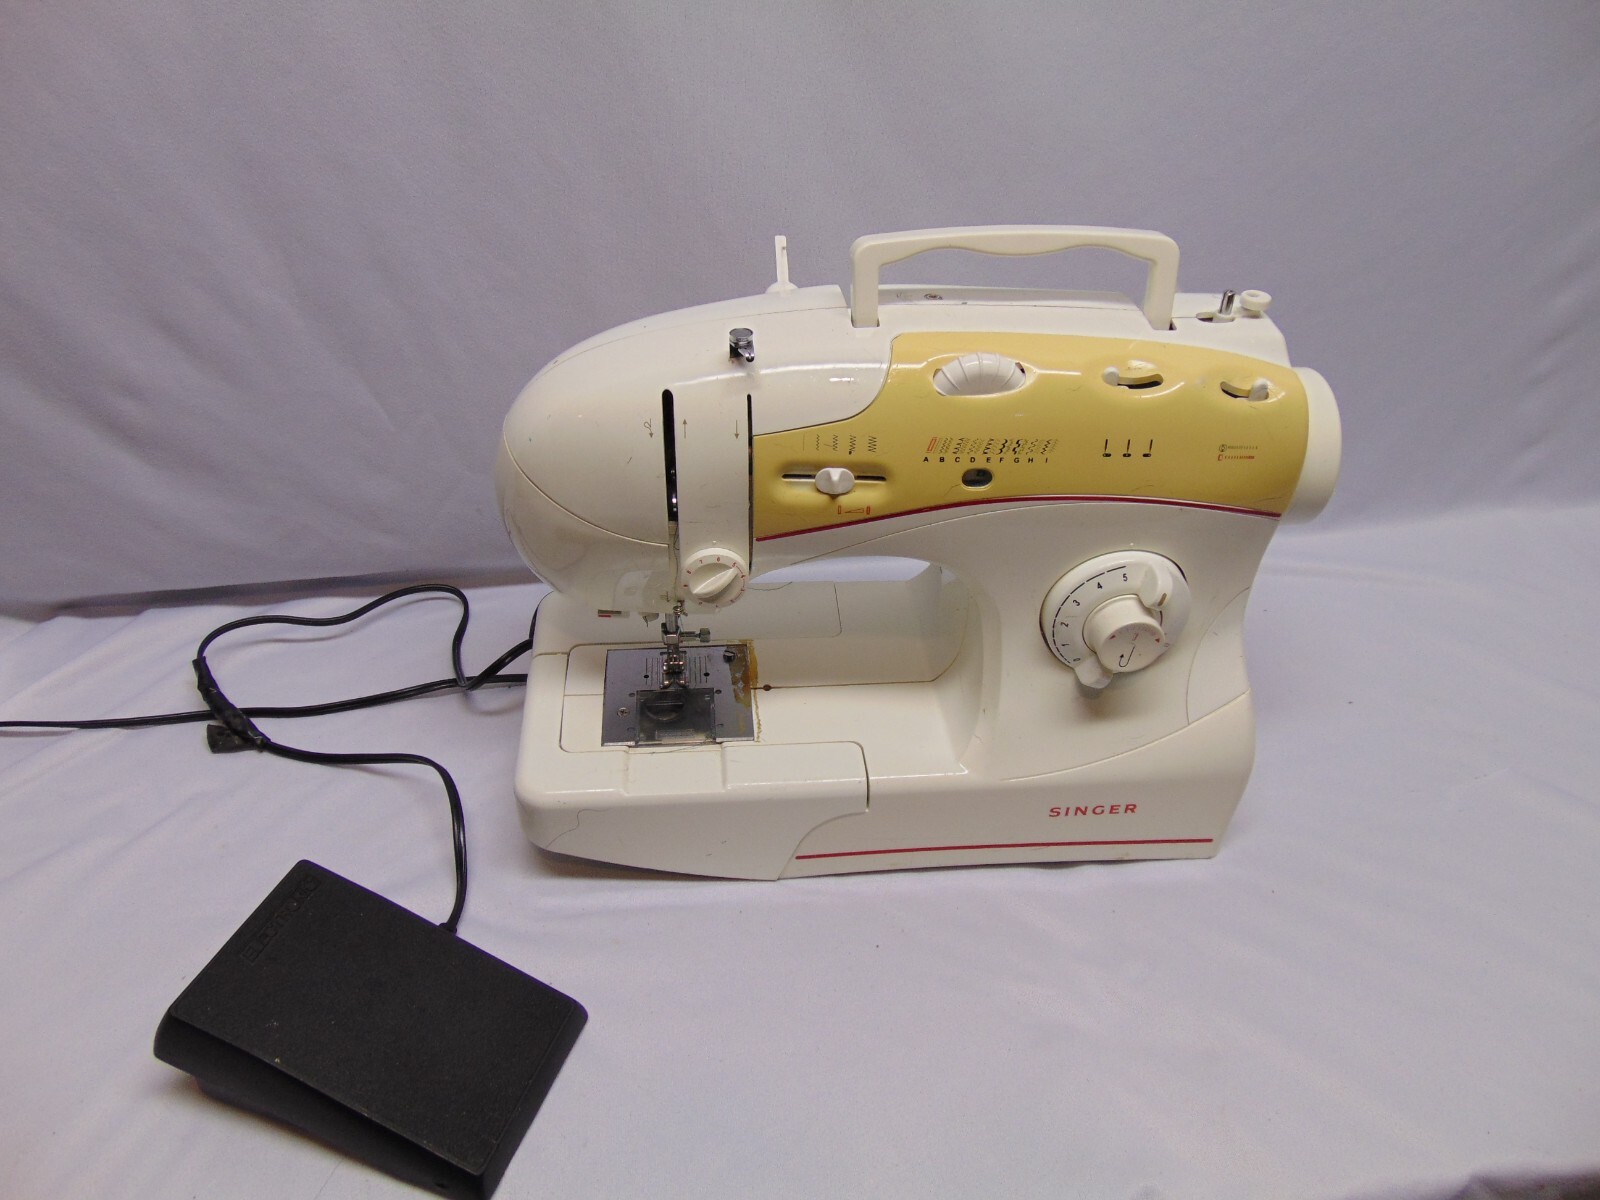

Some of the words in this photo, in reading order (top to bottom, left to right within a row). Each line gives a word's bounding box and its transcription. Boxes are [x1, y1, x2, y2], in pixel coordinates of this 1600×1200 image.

[1072, 599, 1081, 607] 3
[1097, 582, 1103, 590] 4
[1122, 573, 1128, 582] 5
[1049, 804, 1137, 817] SINGER
